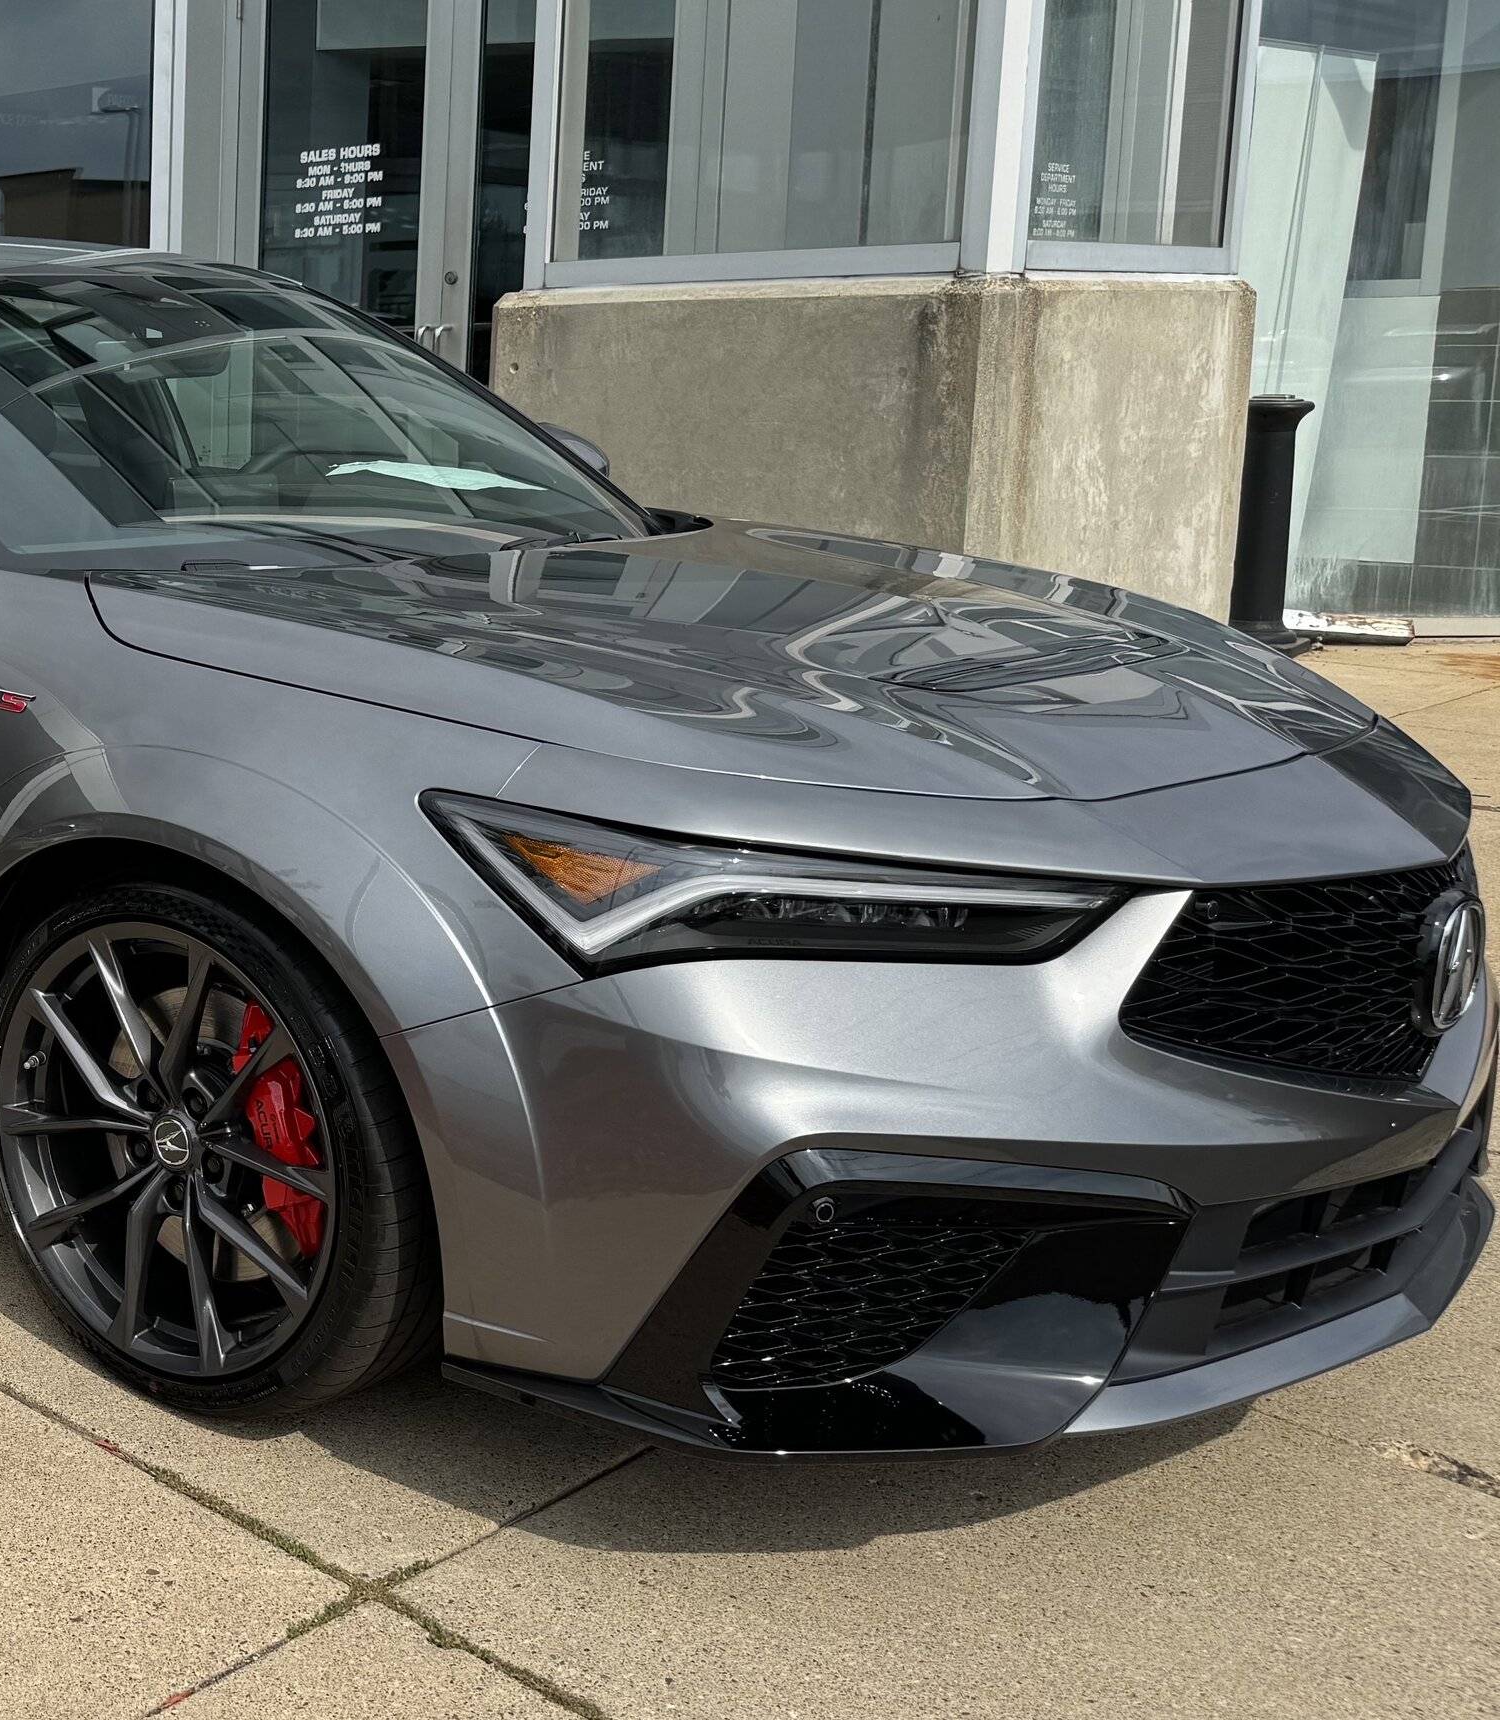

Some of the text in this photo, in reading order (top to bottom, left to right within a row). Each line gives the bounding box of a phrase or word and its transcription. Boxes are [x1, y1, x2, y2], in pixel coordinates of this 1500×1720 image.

[300, 143, 380, 163] SALES HOURS
[308, 165, 331, 176] MON
[319, 176, 334, 186] AM
[367, 171, 383, 182] PM
[322, 187, 355, 200] FRIDAY
[580, 187, 608, 196] RIDAY
[318, 201, 333, 211] AM
[366, 196, 382, 207] PM
[594, 196, 610, 206] PM
[314, 212, 361, 226] SATURDAY
[593, 220, 609, 230] PM
[317, 226, 332, 237] AM
[365, 222, 381, 233] PM
